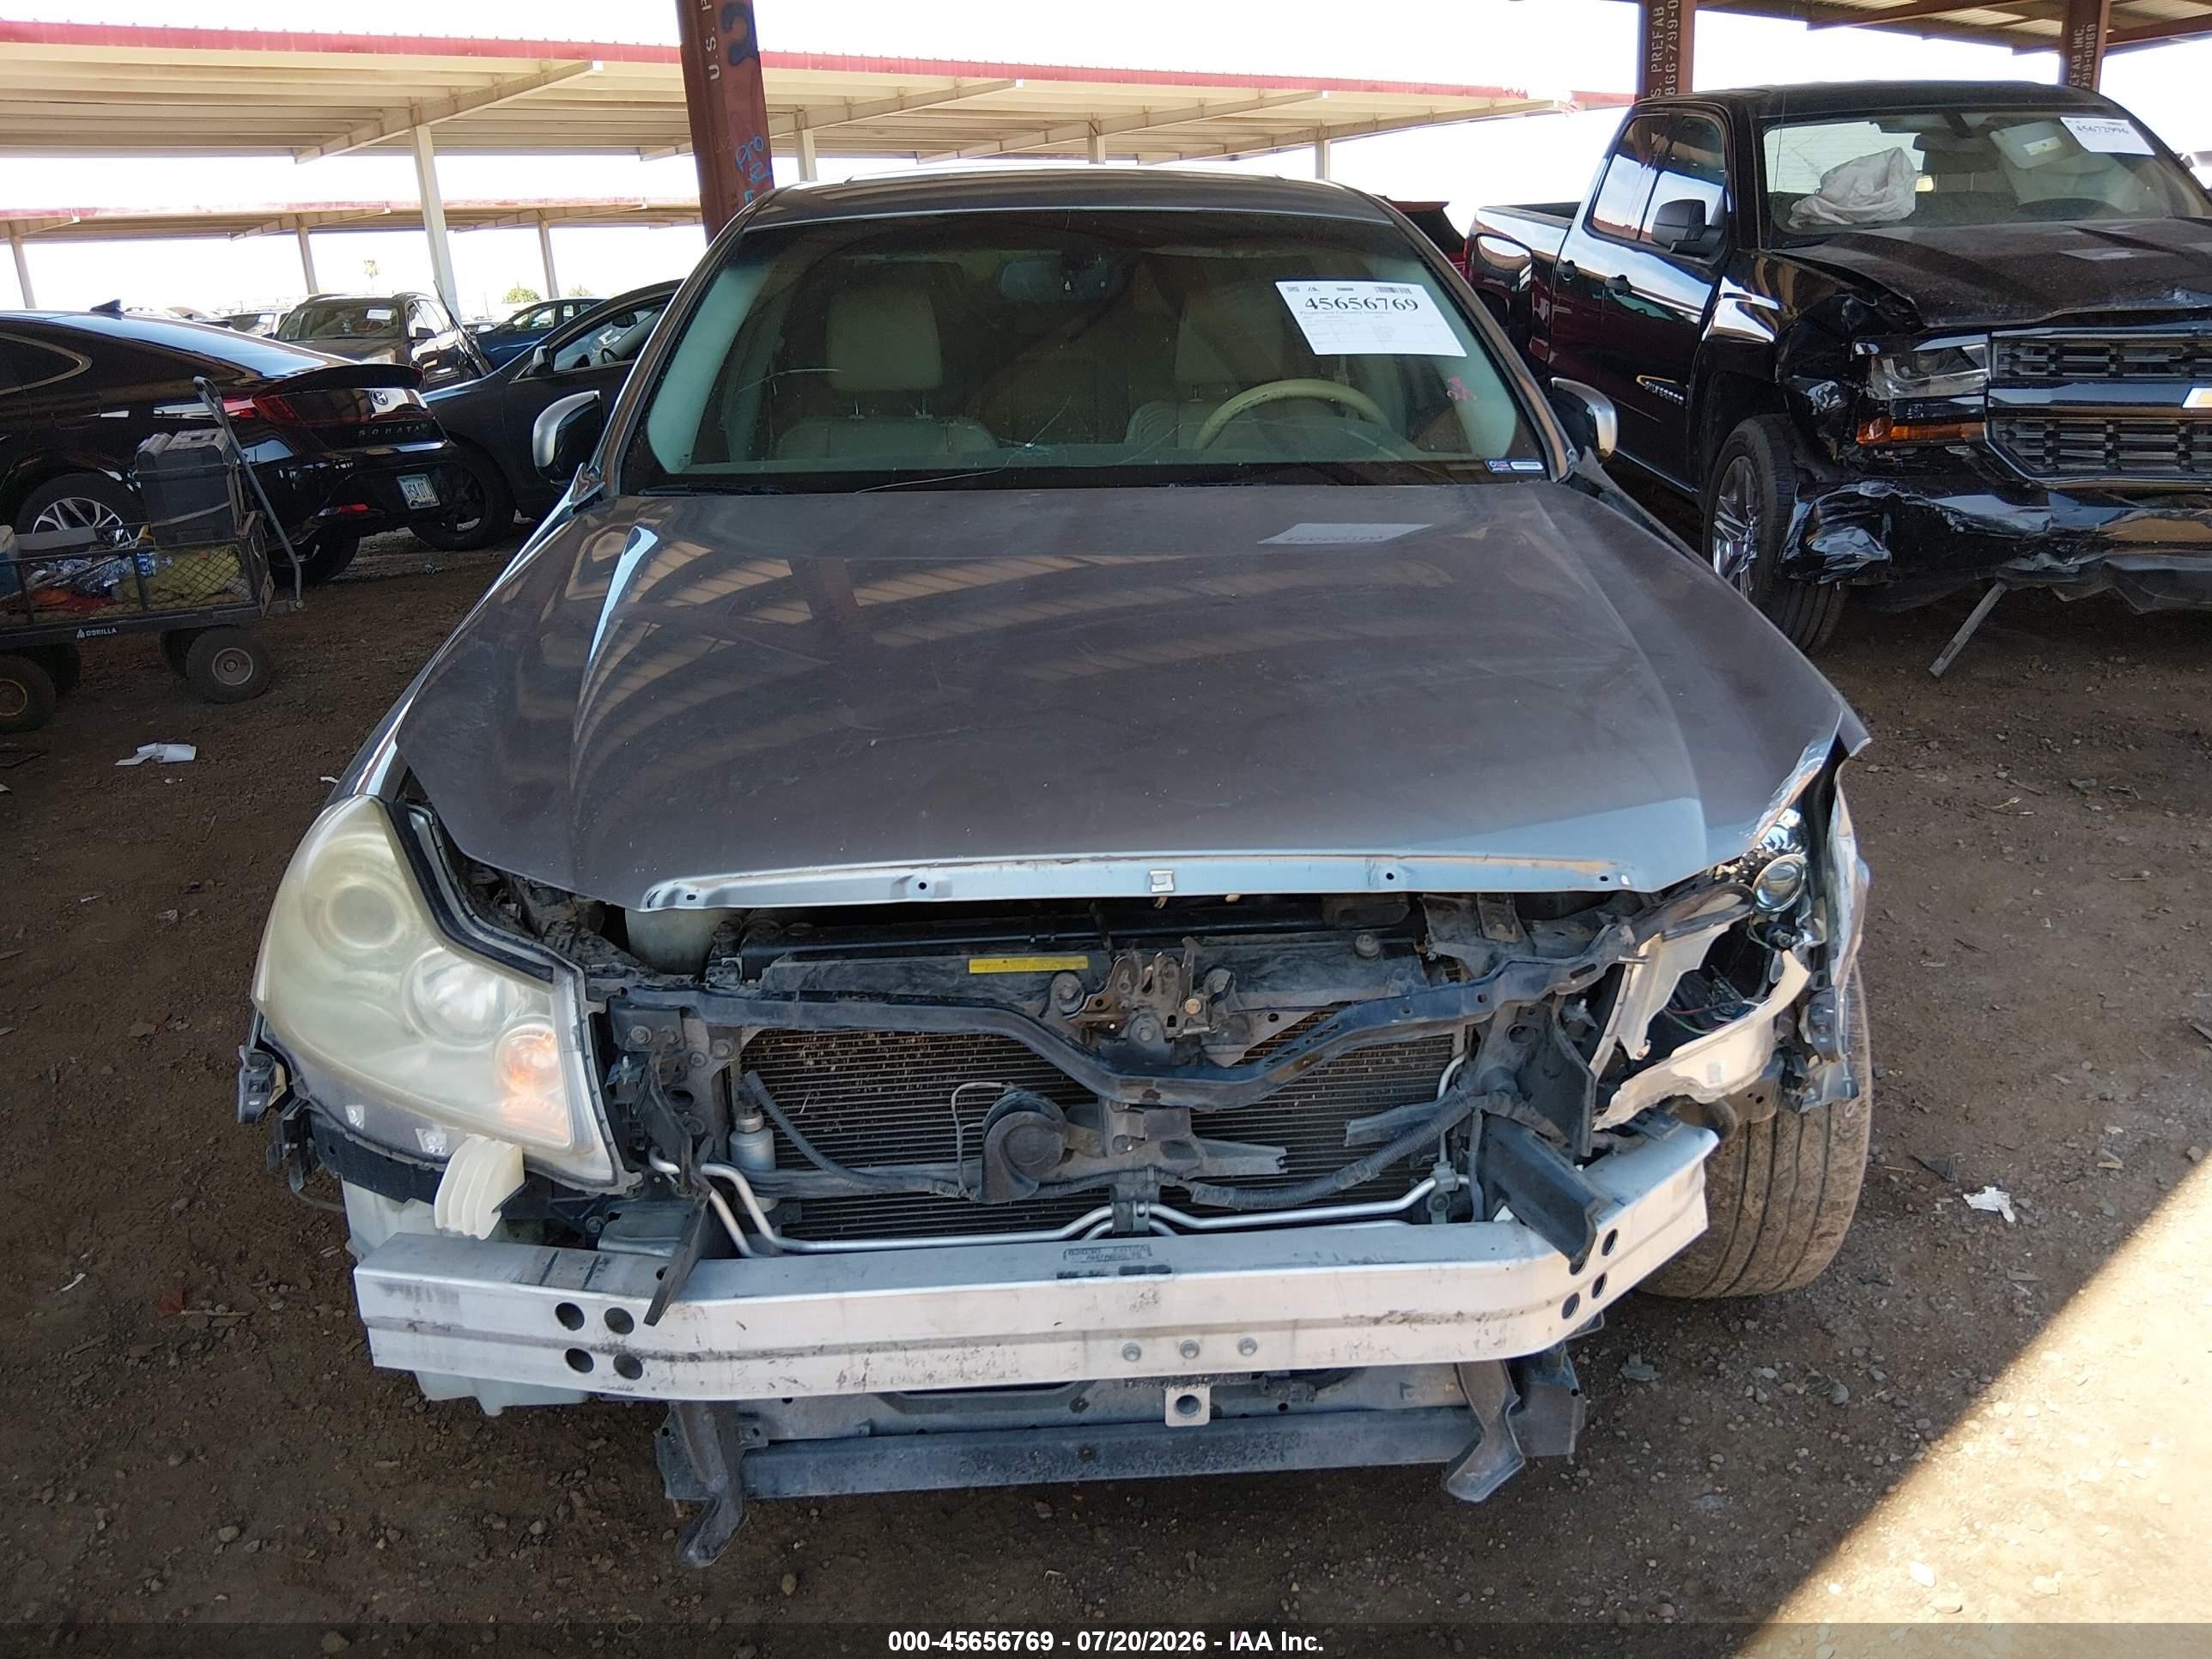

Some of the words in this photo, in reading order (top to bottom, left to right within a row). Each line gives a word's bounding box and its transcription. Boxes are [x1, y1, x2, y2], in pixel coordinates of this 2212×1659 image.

[706, 27, 720, 80] U.S.
[1650, 6, 1665, 73] PREFAB
[1664, 0, 1679, 95] 866-799-0
[2072, 24, 2087, 49] INC.
[1304, 297, 1419, 312] 45656769
